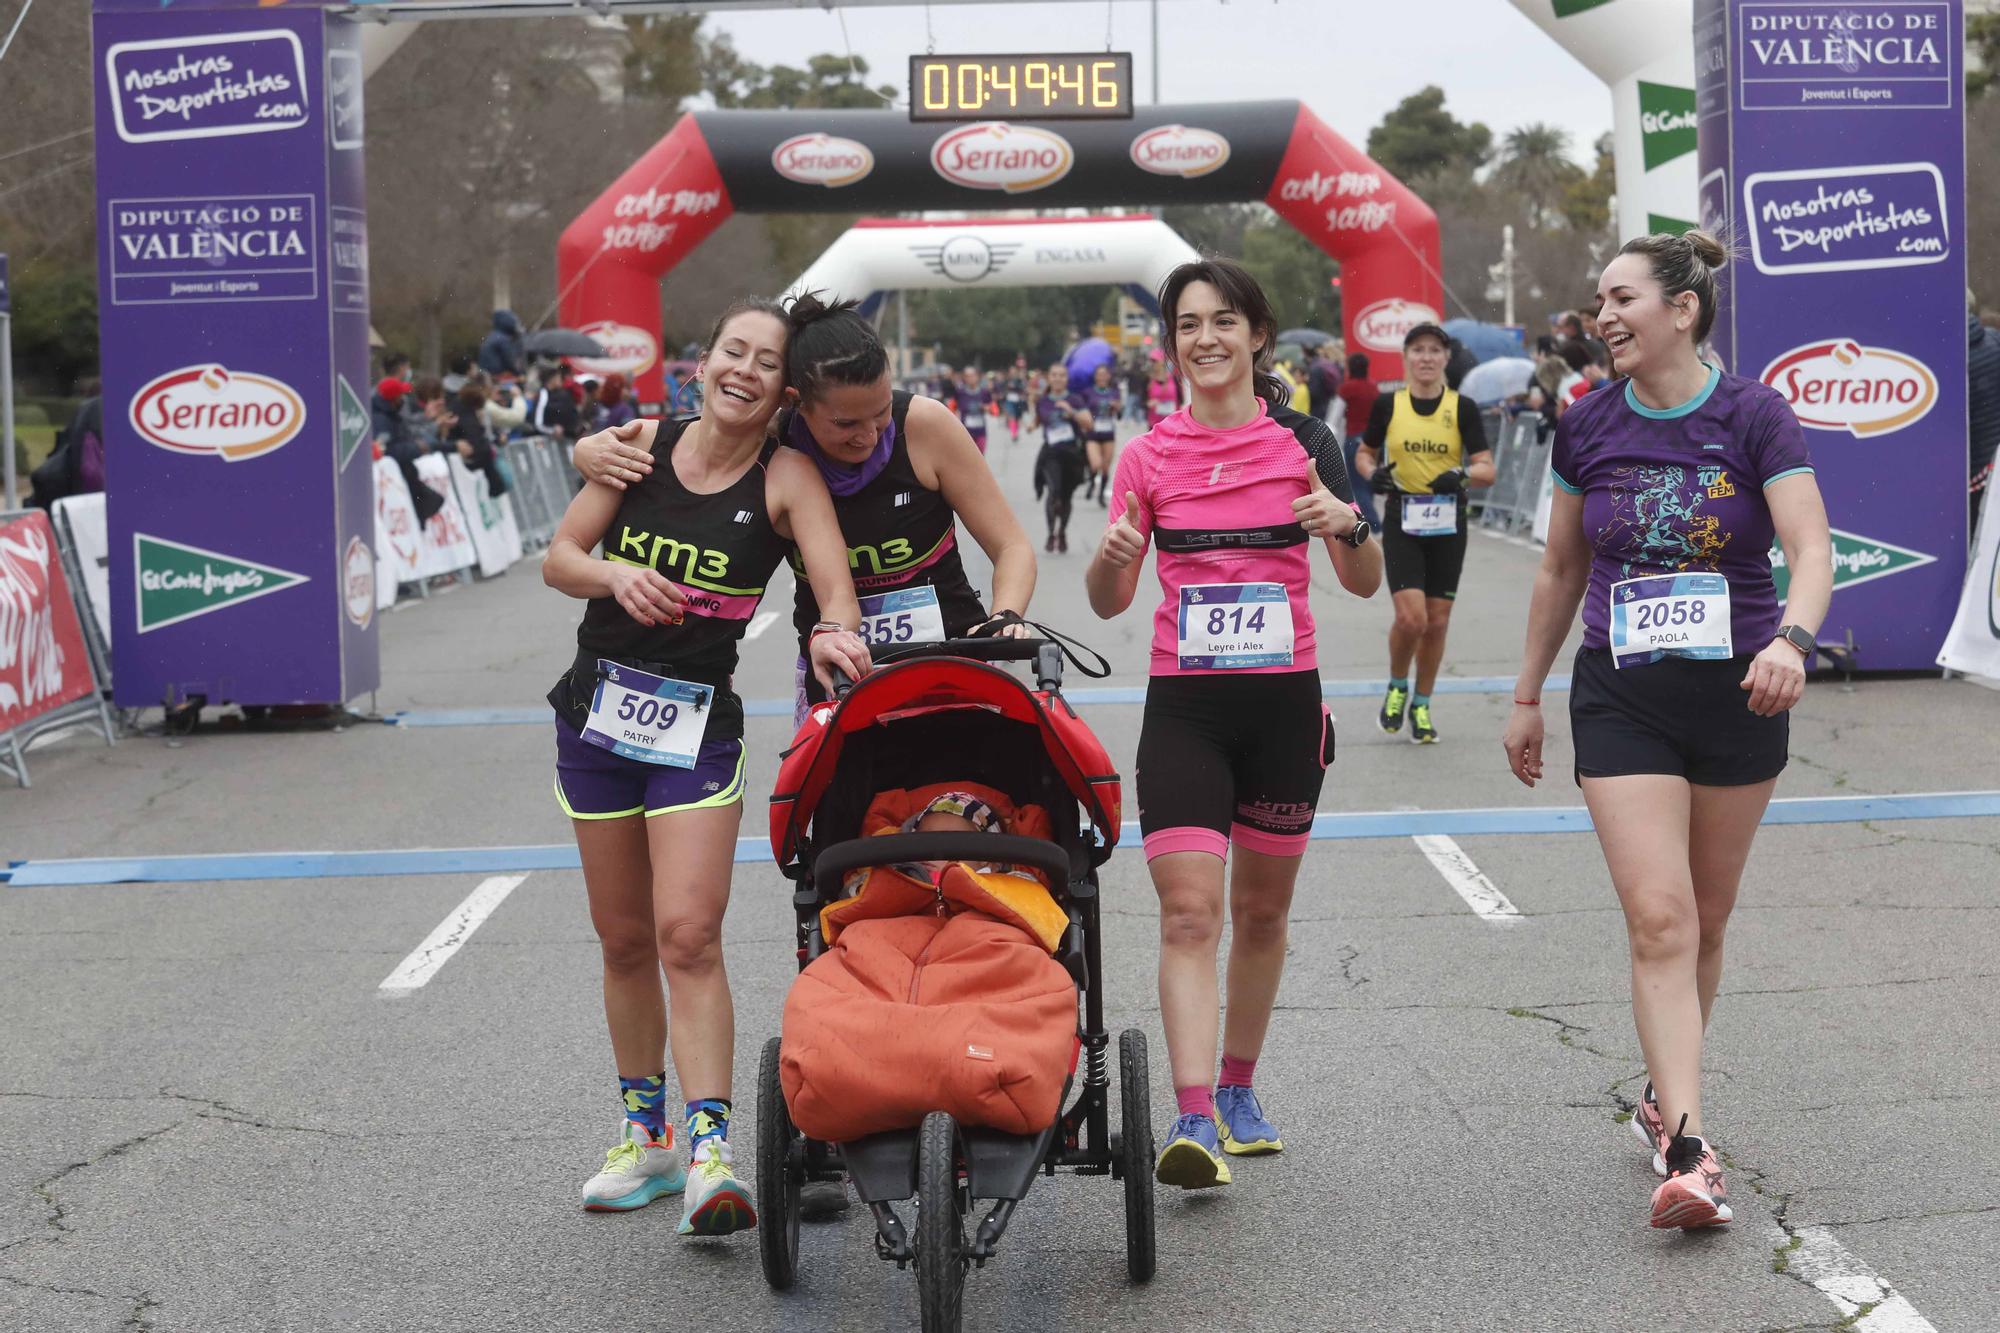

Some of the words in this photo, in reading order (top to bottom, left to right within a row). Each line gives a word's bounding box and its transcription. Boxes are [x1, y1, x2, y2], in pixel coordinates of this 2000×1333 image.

[1750, 11, 1894, 31] DIPUTACIÓ
[1905, 14, 1938, 30] DE
[1749, 33, 1941, 66] VALÈNCIA
[134, 69, 292, 120] Deportistas
[923, 63, 1118, 109] 00:49:46
[1801, 87, 1847, 102] Joventut
[1852, 87, 1893, 102] Esports
[254, 102, 302, 119] .com
[787, 149, 862, 170] Serrano
[950, 142, 1058, 171] Serrano
[1143, 141, 1219, 162] Serrano
[120, 205, 260, 227] DIPUTACIÓ
[270, 206, 303, 222] DE
[1773, 202, 1932, 253] Deportistas
[120, 226, 306, 260] VALÈNCIA
[1895, 235, 1942, 252] .com
[947, 253, 987, 265] MINI
[219, 279, 259, 294] Esports
[1785, 368, 1919, 405] Serrano
[151, 394, 286, 431] Serrano
[1404, 439, 1449, 454] teika
[1697, 470, 1728, 487] 10K
[1710, 484, 1734, 497] FEM
[1422, 506, 1440, 520] 44
[203, 562, 264, 596] Inglés
[1207, 606, 1265, 635] 814
[1637, 600, 1706, 630] 2058
[1208, 643, 1235, 653] Leyre
[1243, 642, 1264, 651] Alex
[1650, 632, 1689, 645] PAOLA
[617, 693, 679, 731] 509
[623, 730, 657, 745] PATRY
